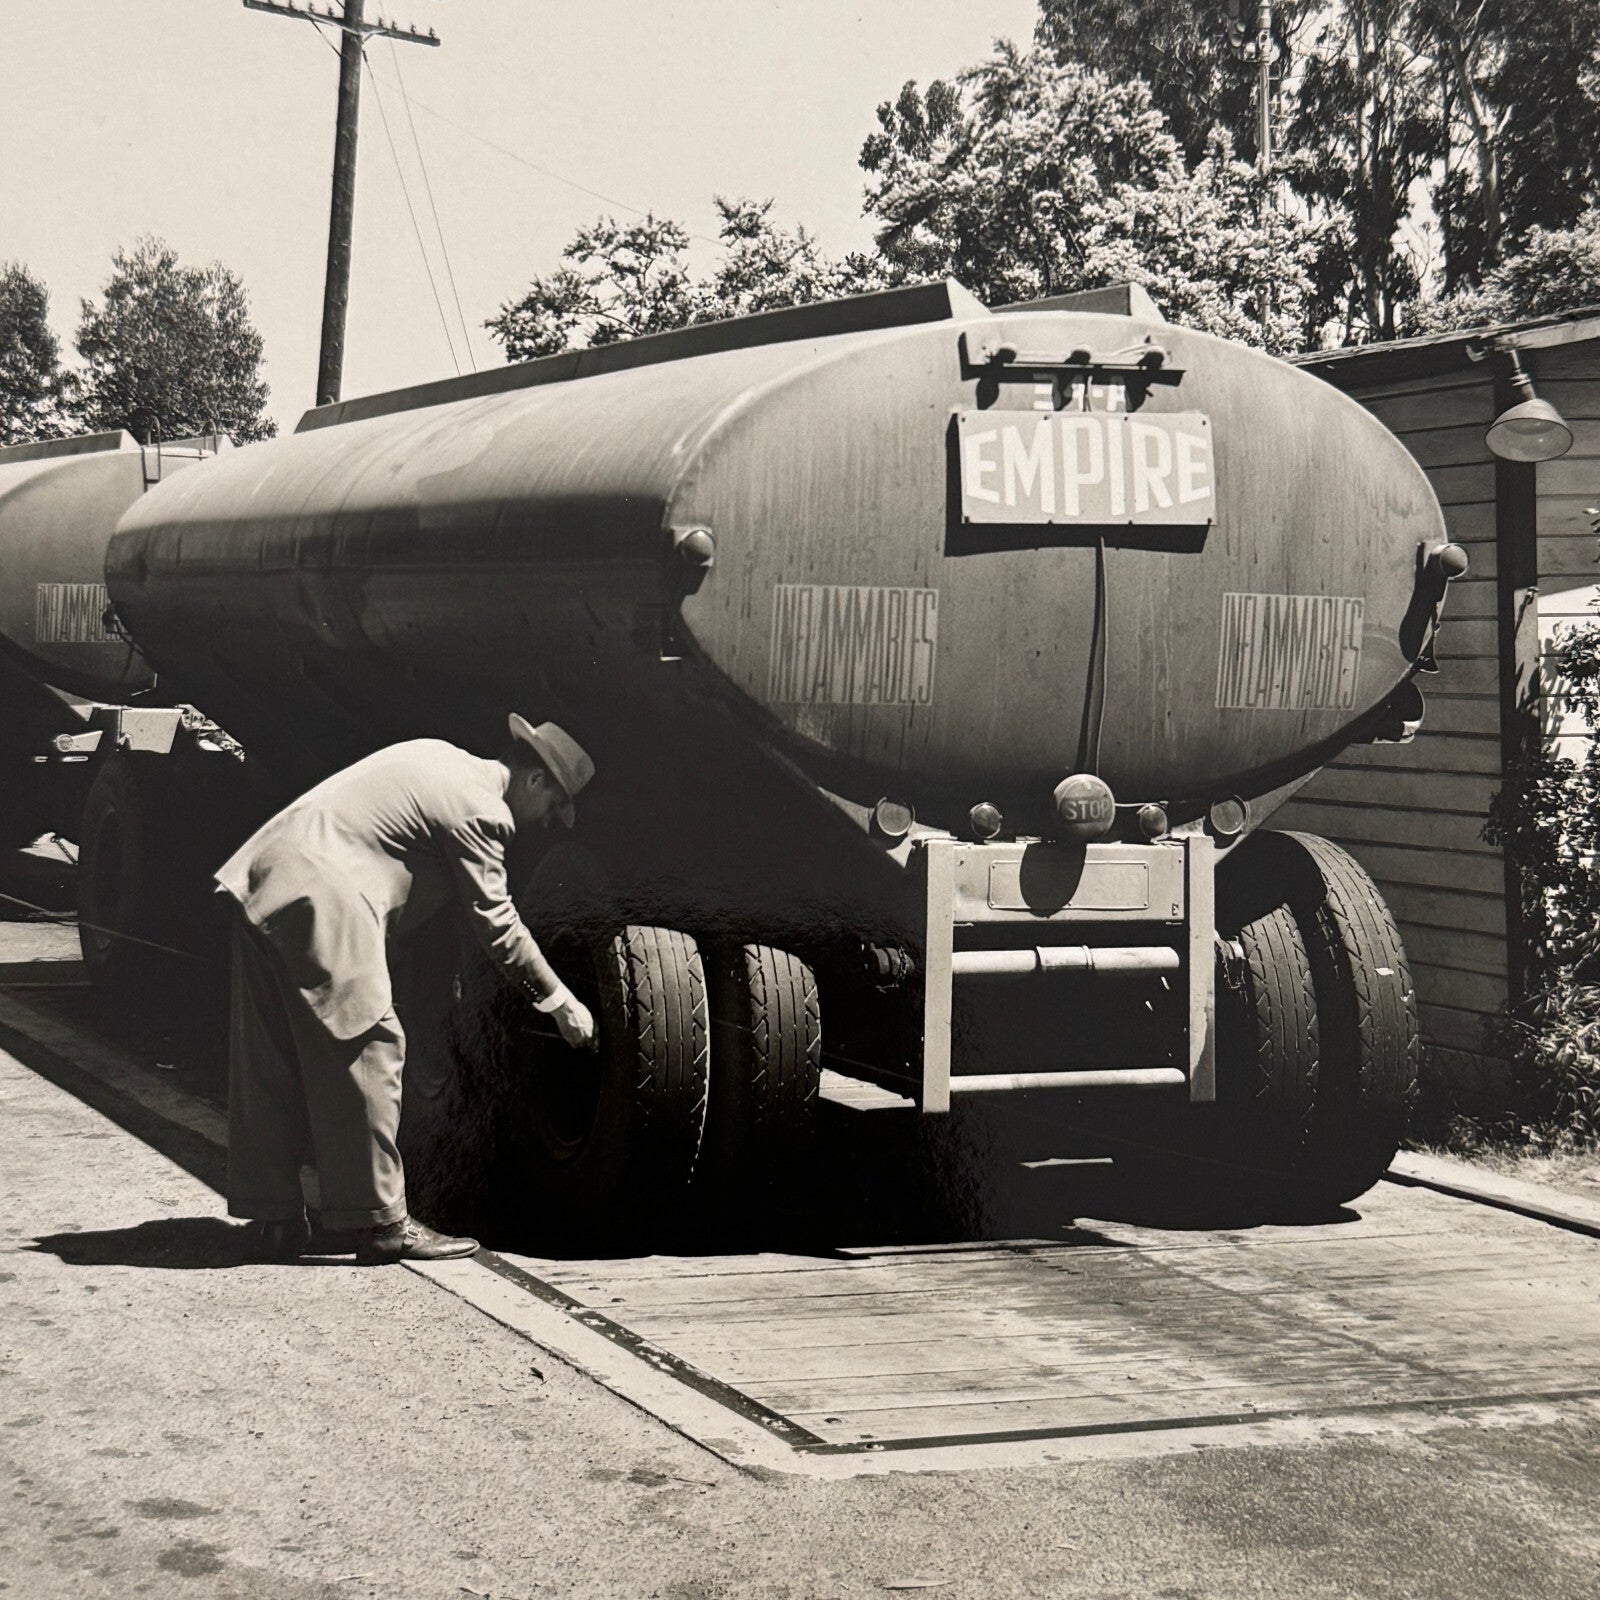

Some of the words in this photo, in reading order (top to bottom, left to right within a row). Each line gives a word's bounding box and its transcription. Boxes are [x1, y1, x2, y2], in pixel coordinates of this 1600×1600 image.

[965, 417, 1211, 516] EMPIRE
[768, 586, 937, 704] INFLAMMABLES
[1216, 594, 1362, 708] INFLAMMABLES
[1065, 800, 1109, 819] STOP
